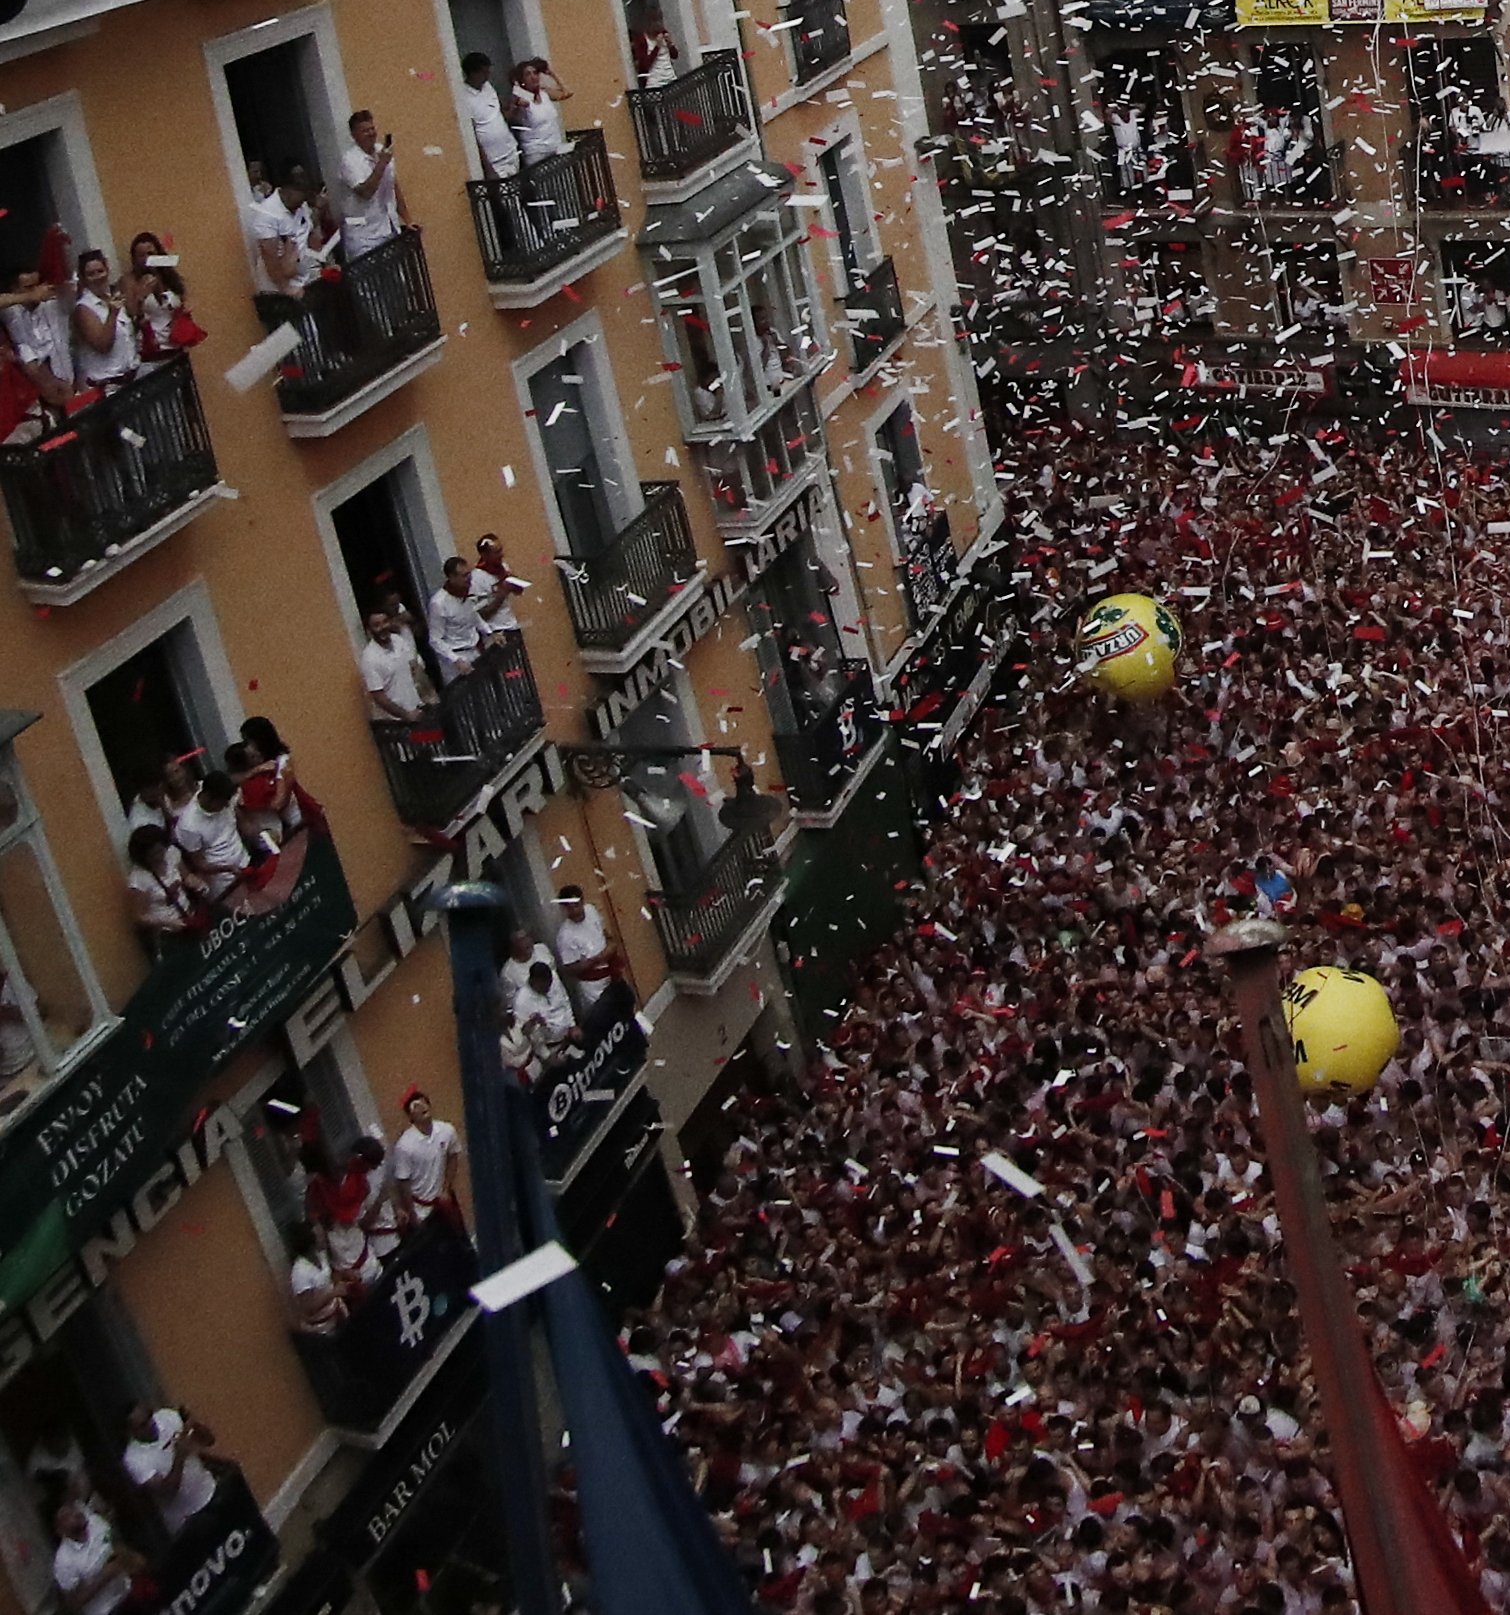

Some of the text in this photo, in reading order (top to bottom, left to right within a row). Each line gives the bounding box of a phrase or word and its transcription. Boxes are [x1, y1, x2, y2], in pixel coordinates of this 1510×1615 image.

[548, 1021, 626, 1123] Bitnovo
[51, 1073, 149, 1188] DISFRUTA
[64, 1116, 146, 1218] GOZATU
[366, 1421, 458, 1544] BAR MOL
